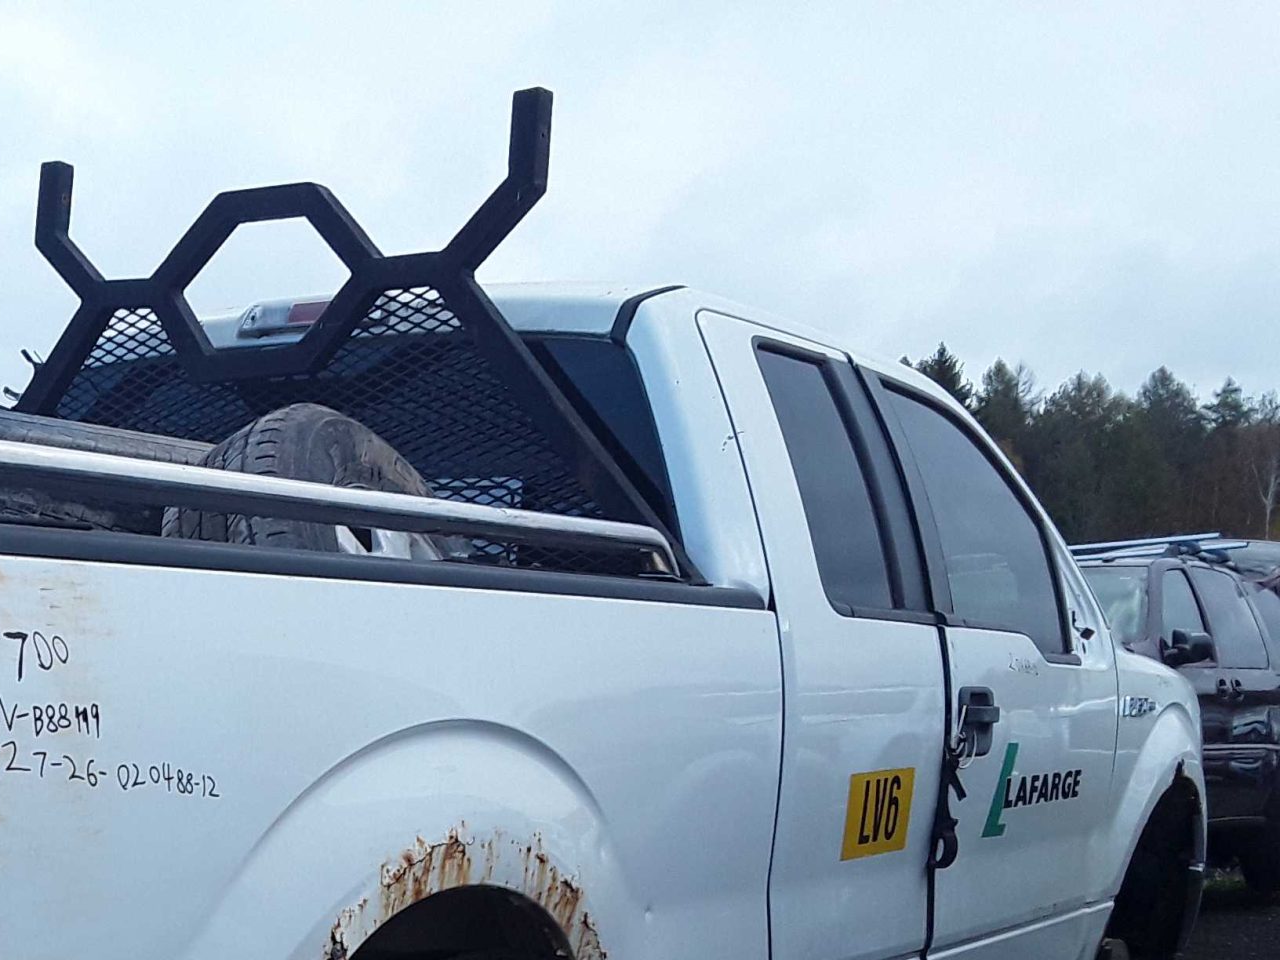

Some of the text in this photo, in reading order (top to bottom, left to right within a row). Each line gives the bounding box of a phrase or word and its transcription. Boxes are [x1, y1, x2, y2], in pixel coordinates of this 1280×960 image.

[3, 631, 69, 682] 700
[857, 775, 902, 846] LV6
[1003, 769, 1083, 809] LAFARGE
